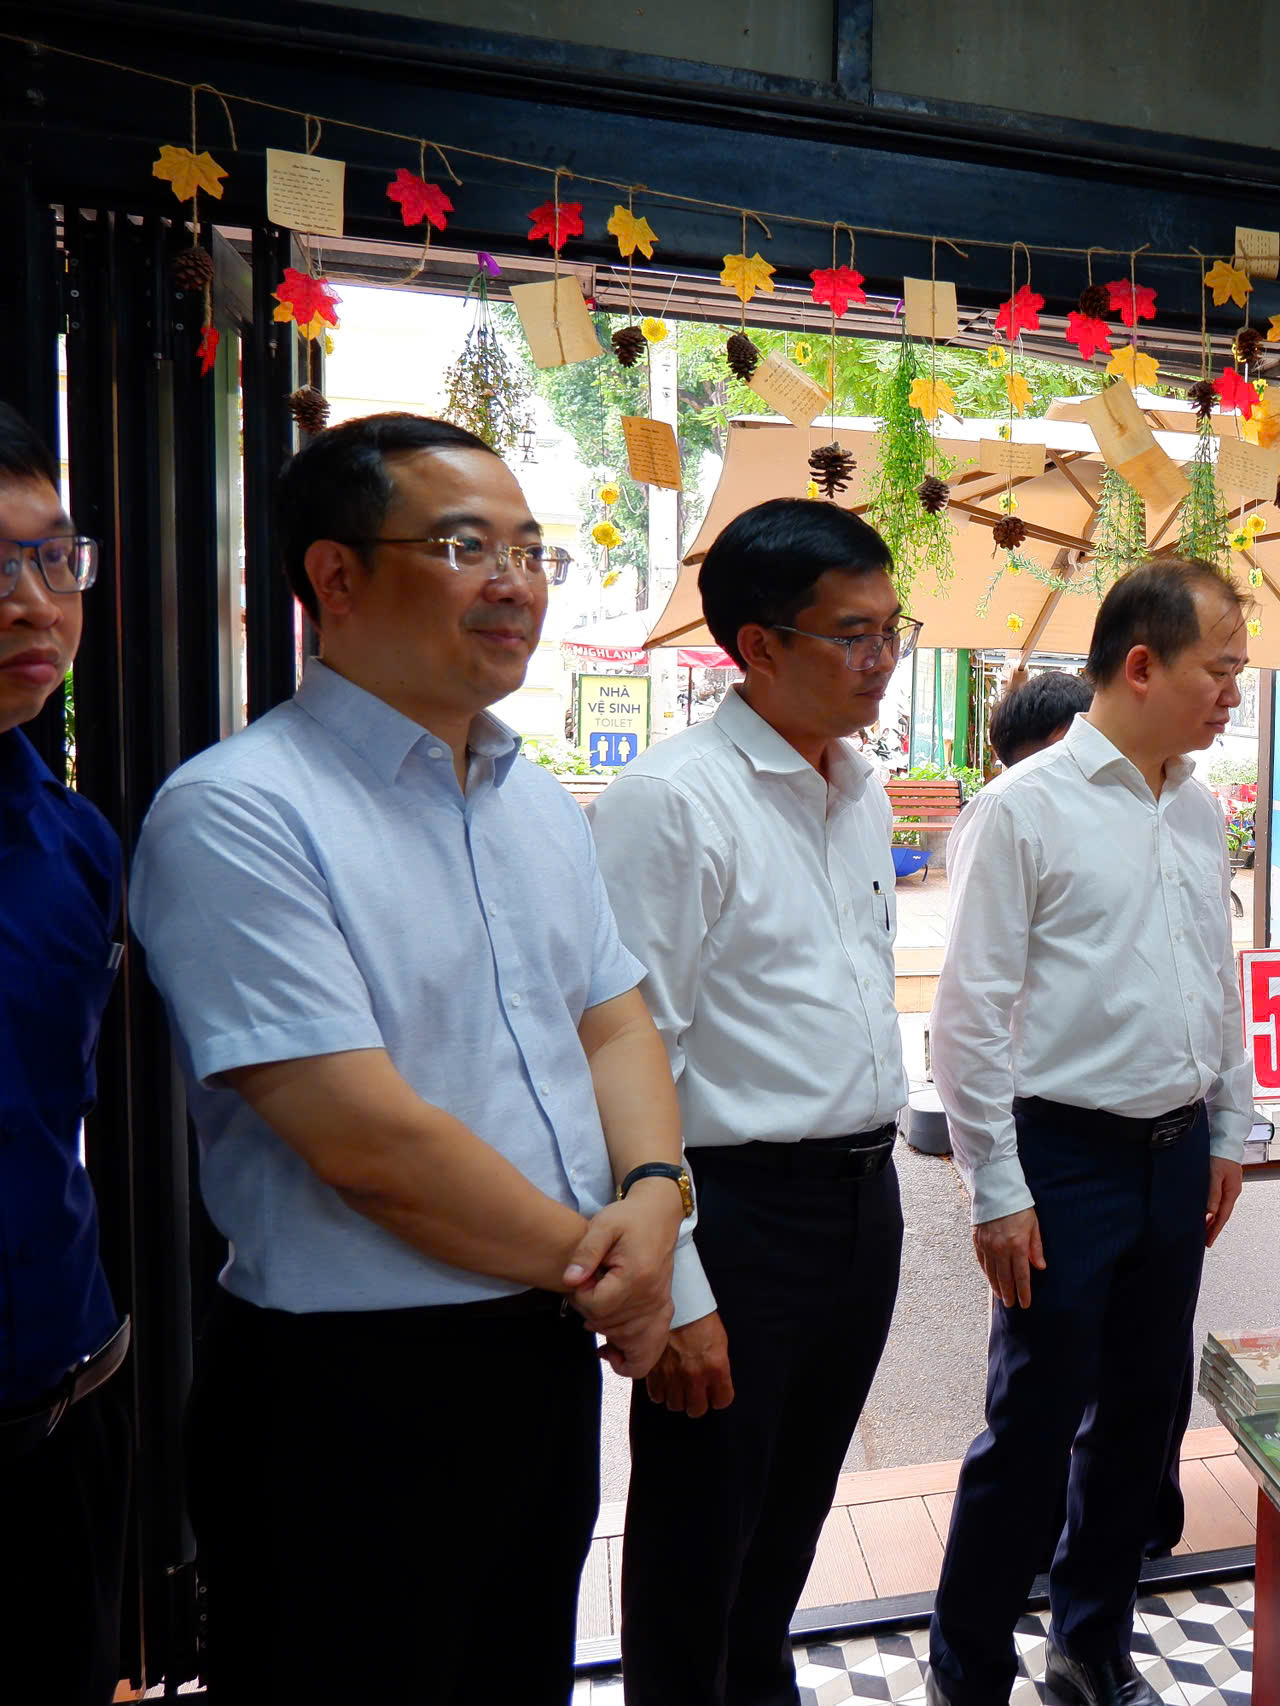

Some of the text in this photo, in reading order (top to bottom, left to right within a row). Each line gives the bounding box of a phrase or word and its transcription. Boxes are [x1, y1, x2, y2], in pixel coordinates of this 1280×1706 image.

[600, 685, 630, 698] NHÀ
[588, 700, 641, 715] VỆ SINH
[595, 718, 632, 728] TOILET
